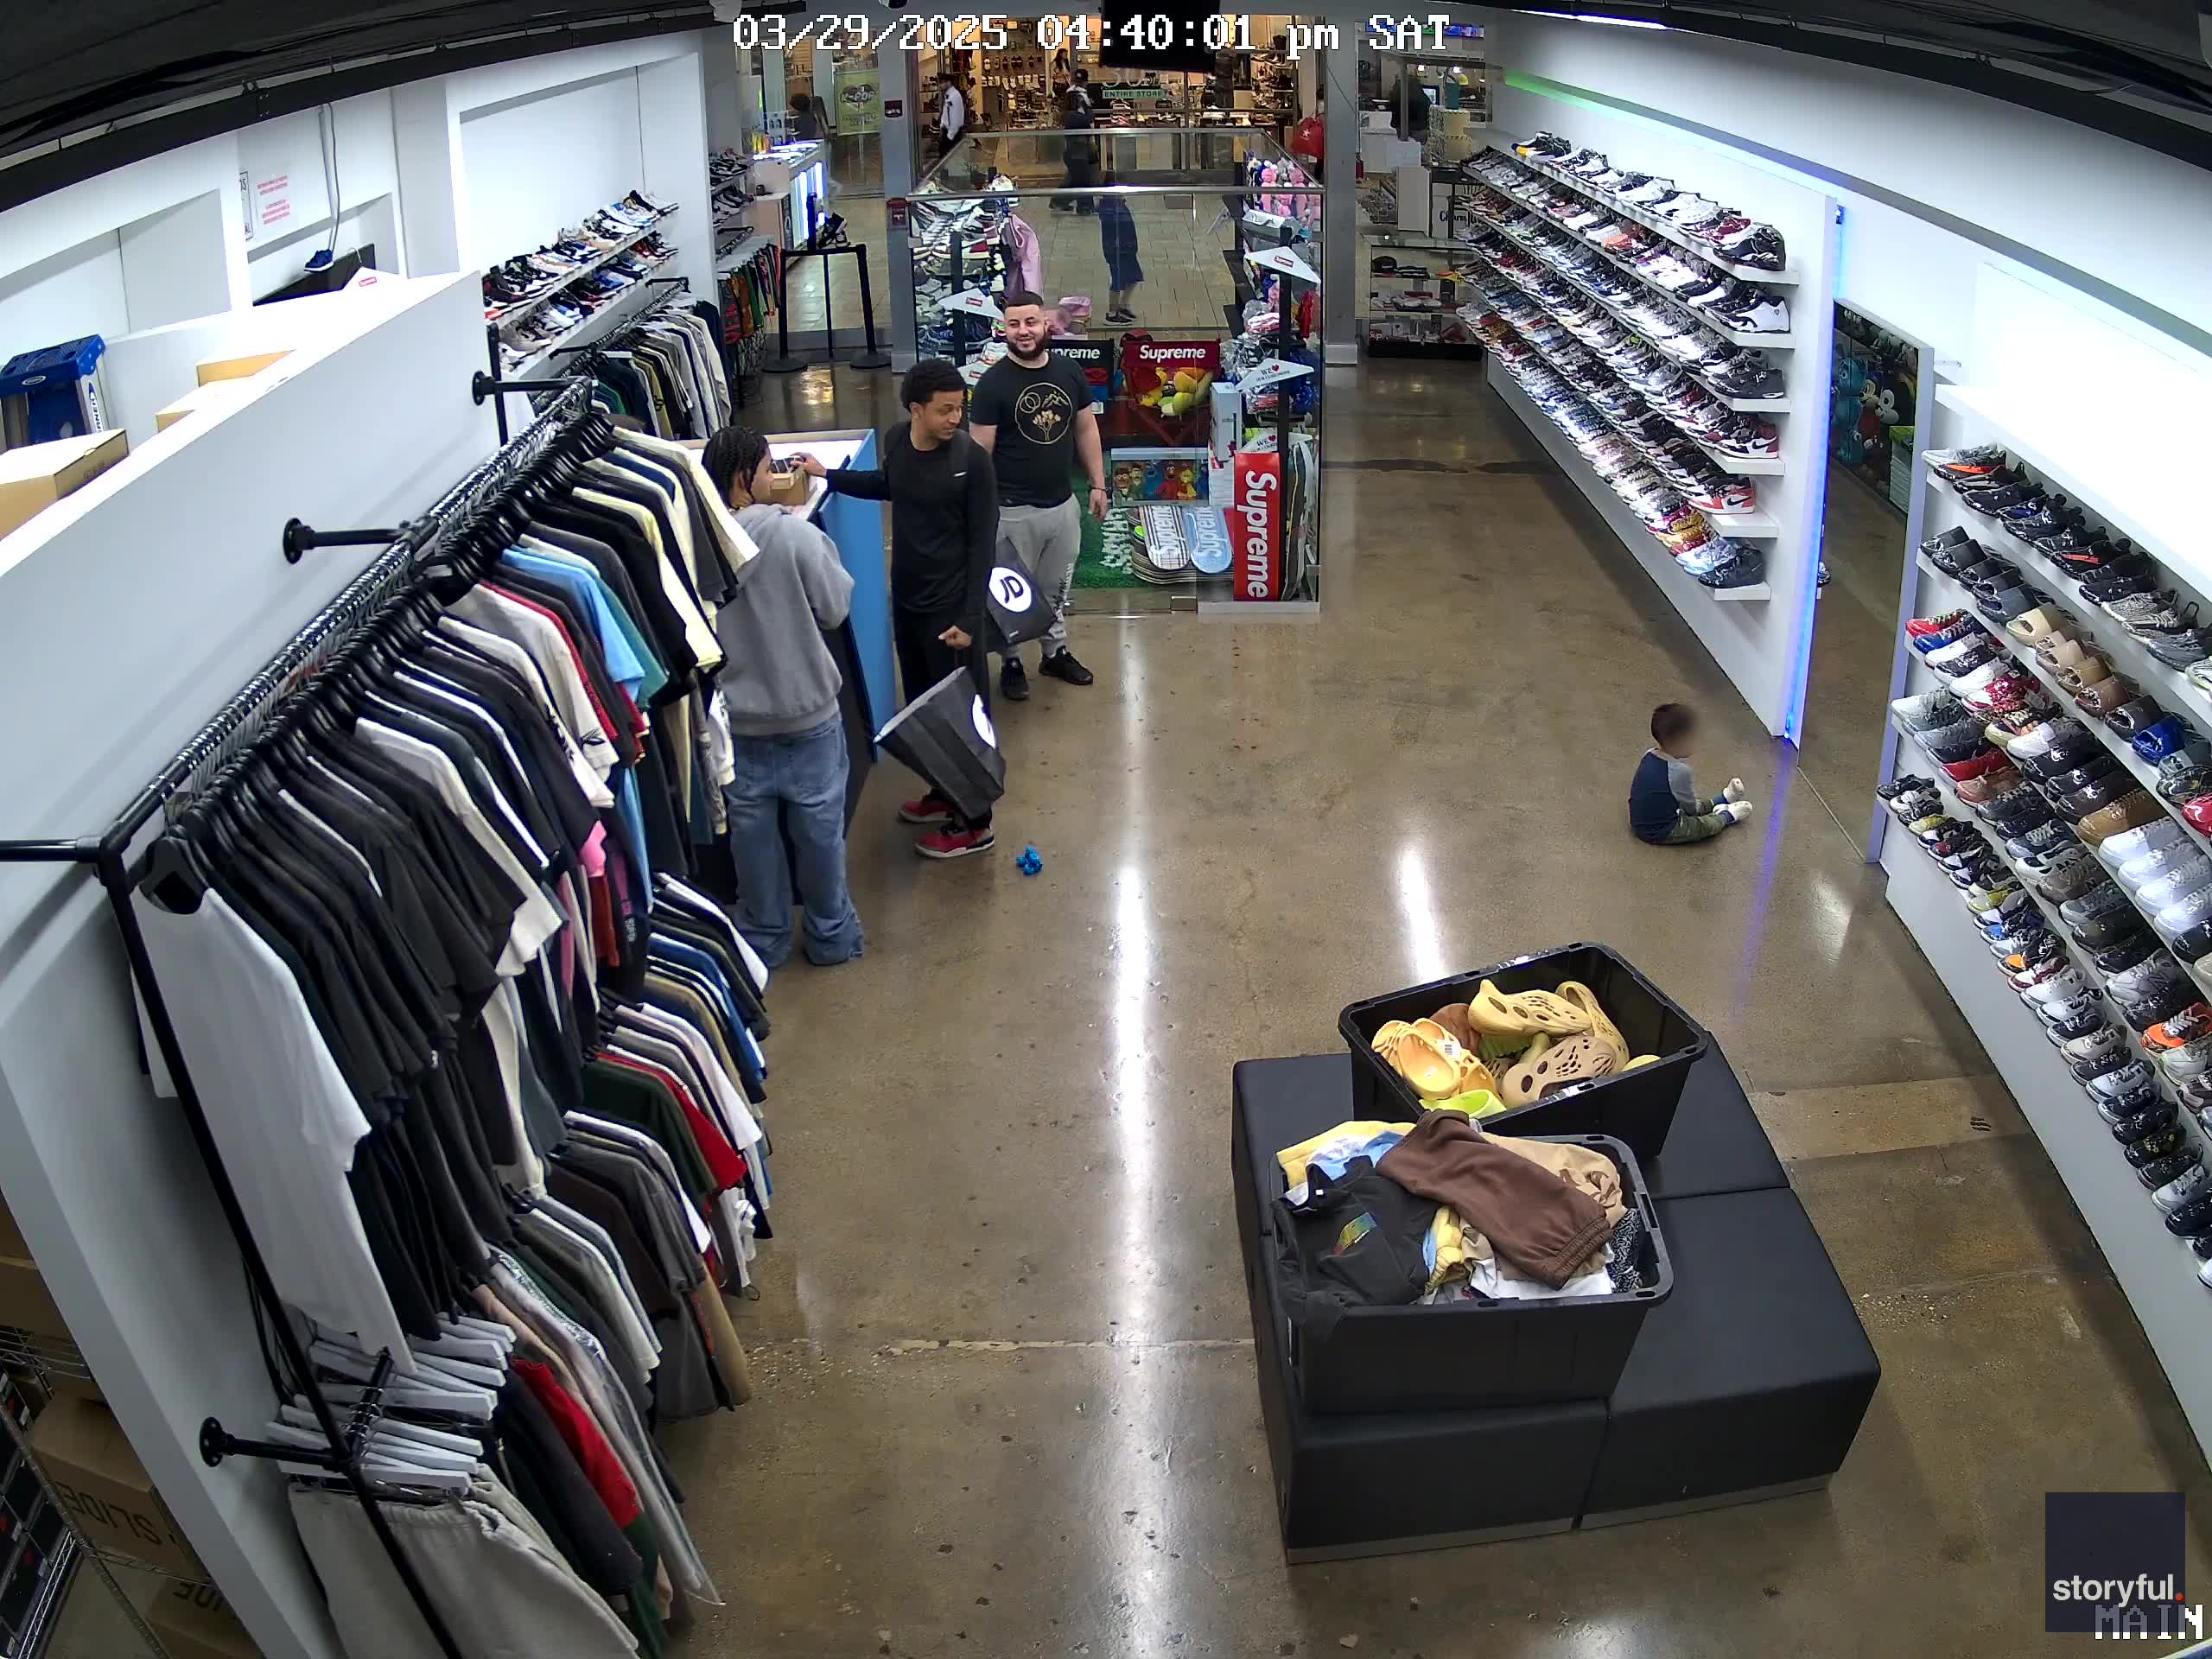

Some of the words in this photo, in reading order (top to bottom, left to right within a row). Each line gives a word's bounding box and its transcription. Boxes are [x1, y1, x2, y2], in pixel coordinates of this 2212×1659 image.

[1051, 348, 1100, 359] preme
[1140, 345, 1206, 363] Supreme
[1236, 470, 1277, 598] Supreme
[1000, 575, 1024, 604] JD
[54, 1480, 162, 1545] SLIDE
